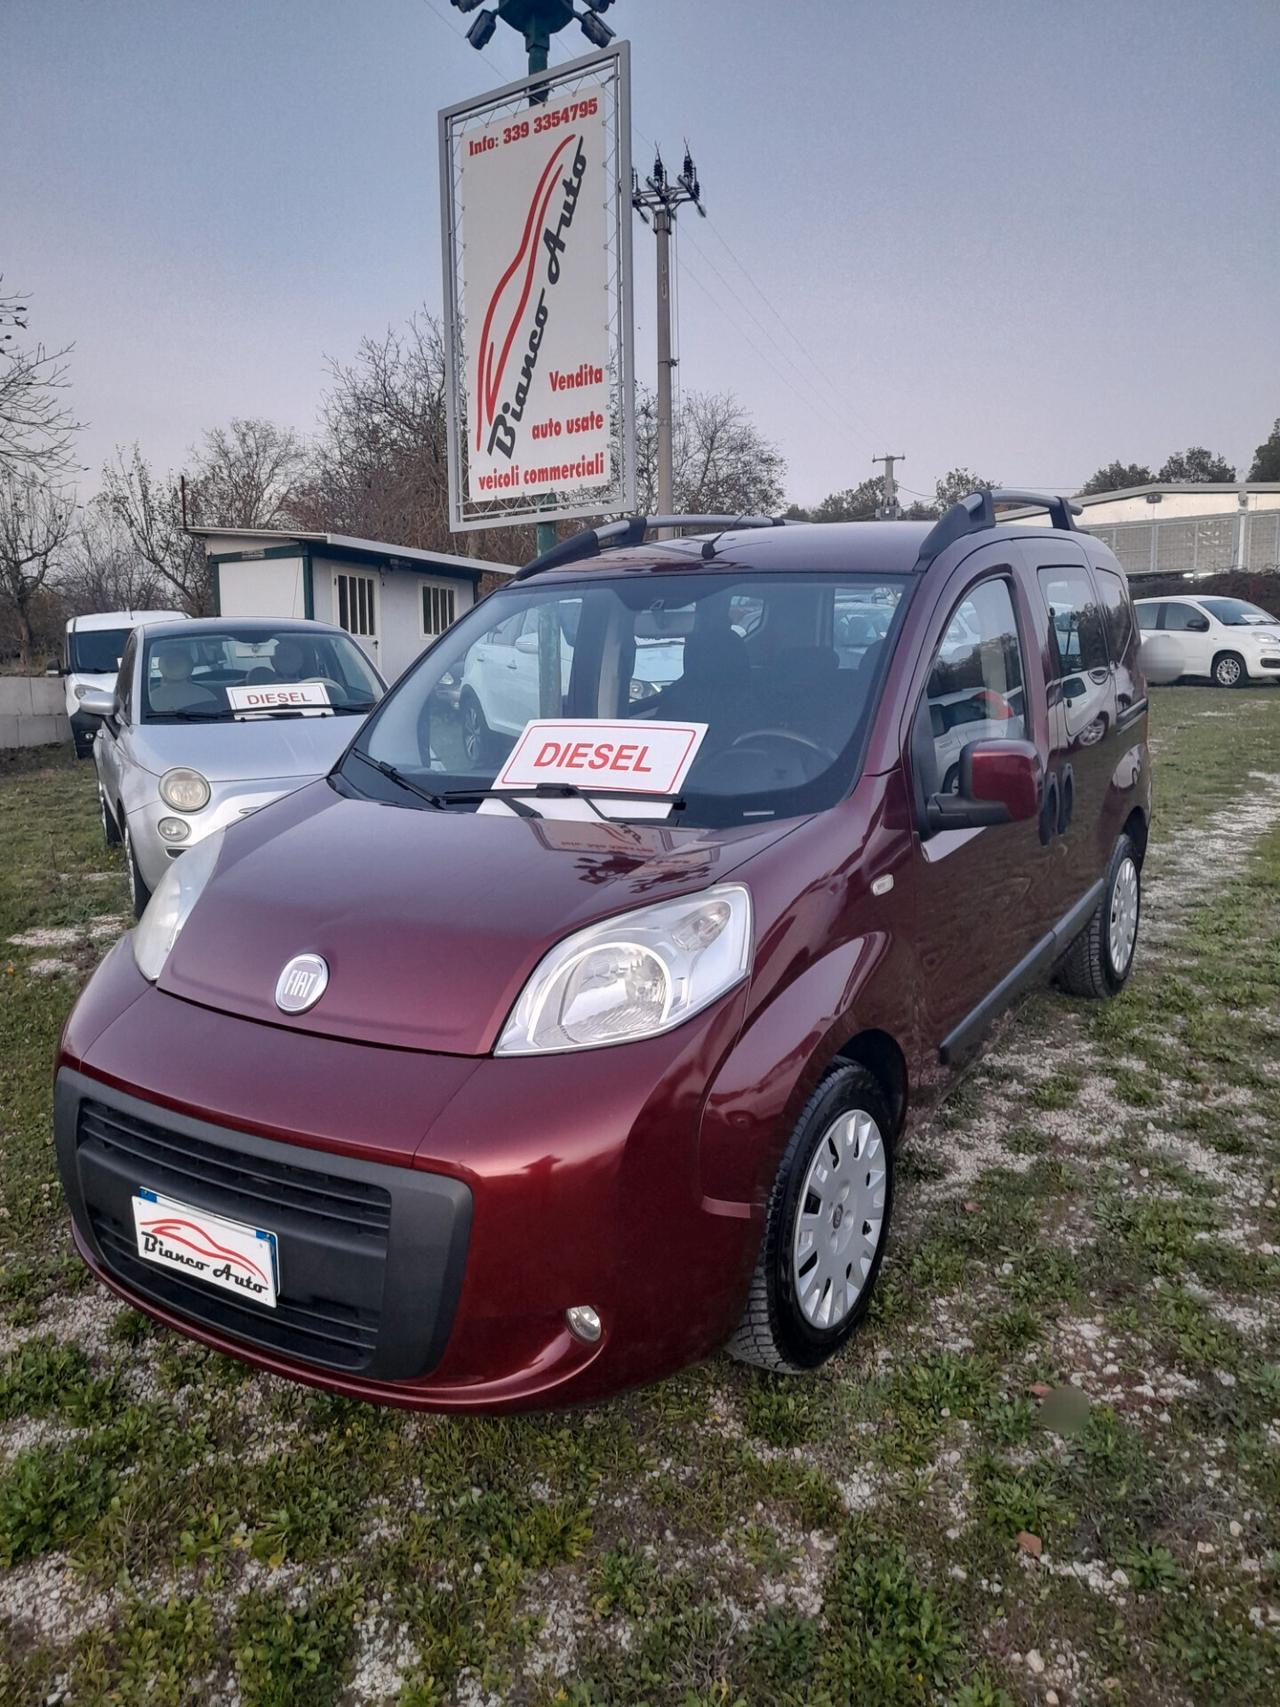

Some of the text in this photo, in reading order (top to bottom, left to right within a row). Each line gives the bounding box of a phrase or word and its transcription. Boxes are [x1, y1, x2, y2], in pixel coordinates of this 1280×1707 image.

[469, 97, 598, 156] Info: 339 3354795
[487, 135, 586, 460] Bianco Auto
[549, 363, 603, 392] Vendita
[532, 410, 604, 440] auto usate
[478, 451, 604, 490] veicoli commerciali
[247, 691, 312, 705] DIESEL
[533, 741, 652, 773] DIESEL
[284, 969, 317, 998] FIAT
[141, 1231, 269, 1294] Bianco Auto
